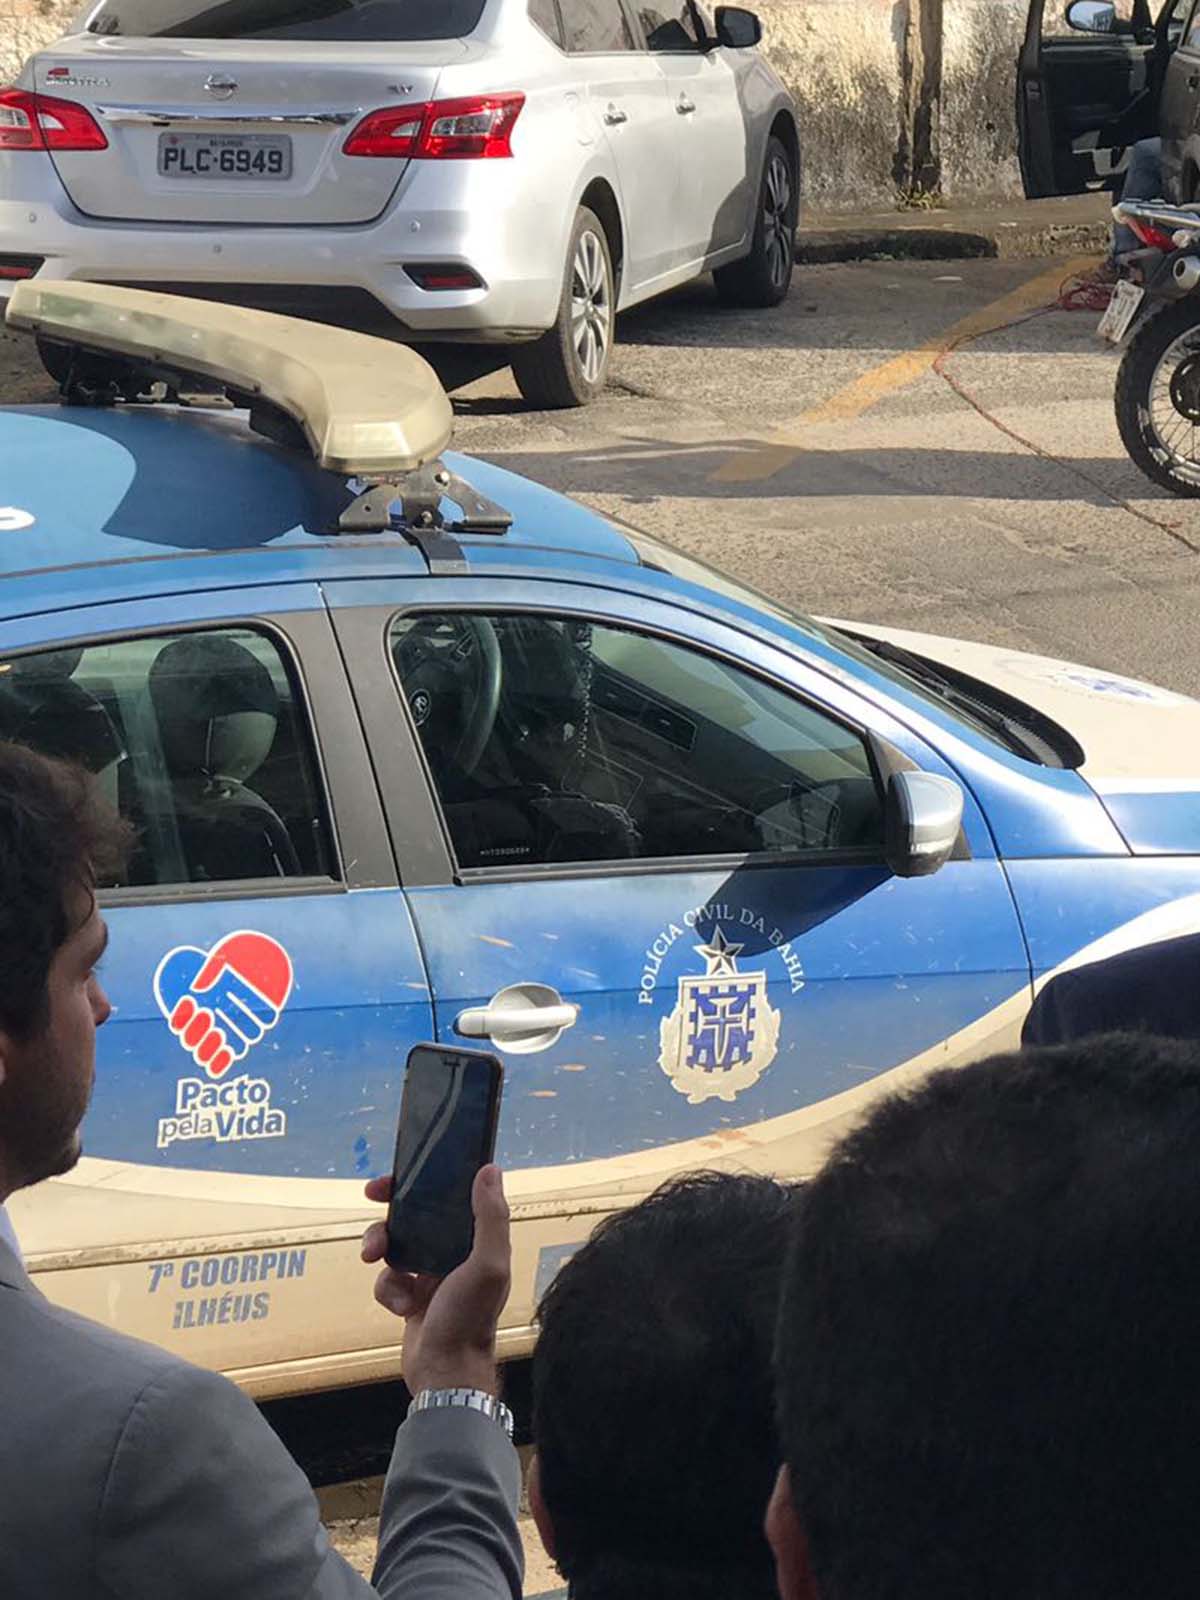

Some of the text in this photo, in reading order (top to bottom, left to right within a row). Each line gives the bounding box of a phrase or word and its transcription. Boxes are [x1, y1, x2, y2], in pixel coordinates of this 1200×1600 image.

[638, 903, 806, 1004] POLÍCIA CIVIL DA BAHIA
[179, 1078, 269, 1111] Pacto
[161, 1105, 284, 1144] pela Vida
[179, 1249, 308, 1290] COORPIN
[172, 1291, 271, 1330] ILHÉUS
